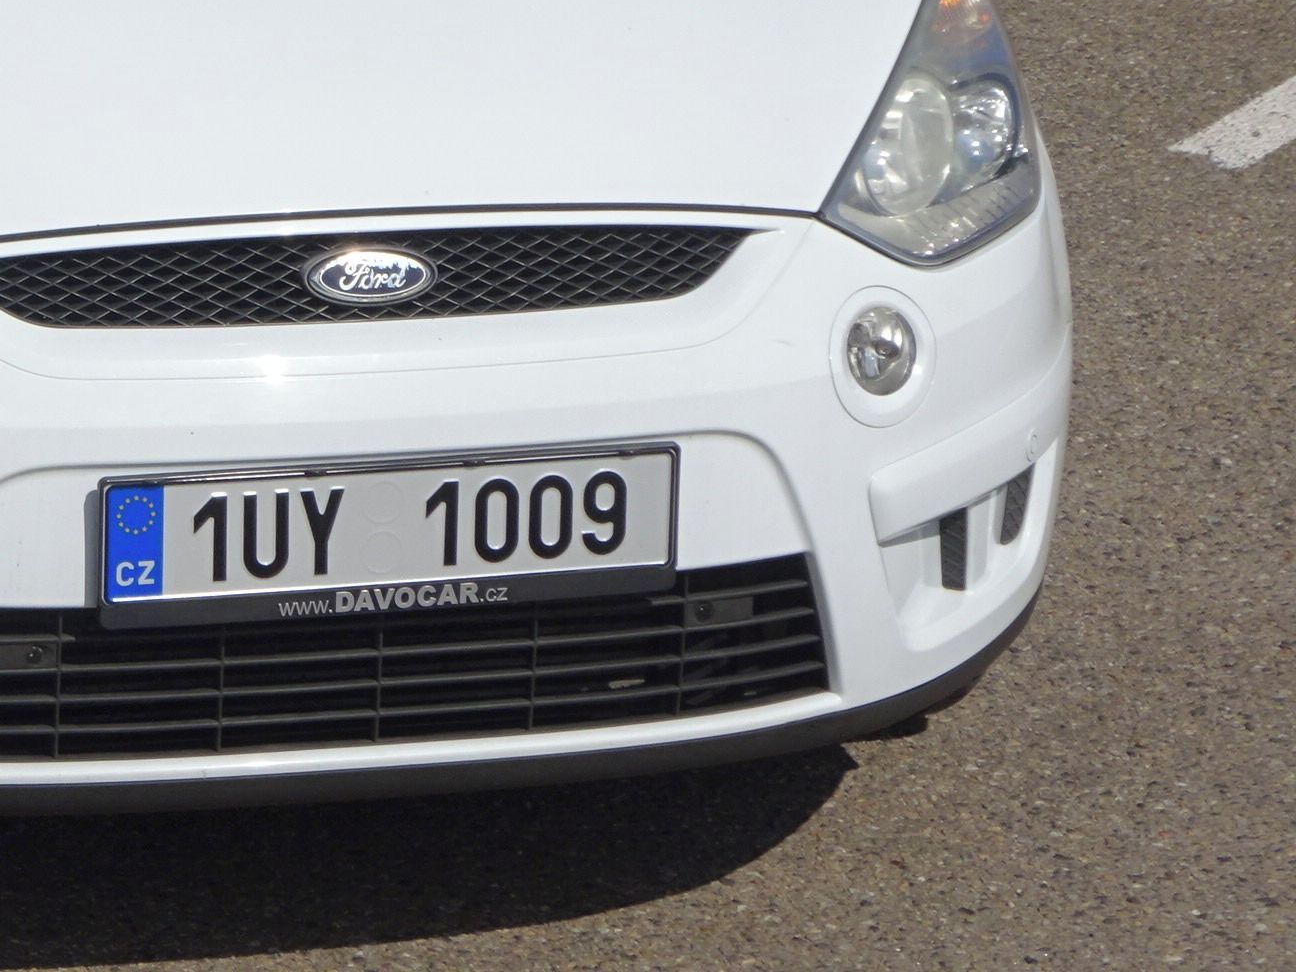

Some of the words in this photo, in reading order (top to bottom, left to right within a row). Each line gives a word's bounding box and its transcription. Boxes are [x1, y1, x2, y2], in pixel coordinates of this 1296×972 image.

[338, 258, 406, 290] Ford
[193, 487, 345, 582] 1UY
[425, 468, 628, 567] 1009
[115, 560, 155, 587] CZ
[278, 582, 508, 616] www.DAVOCAR.cz
